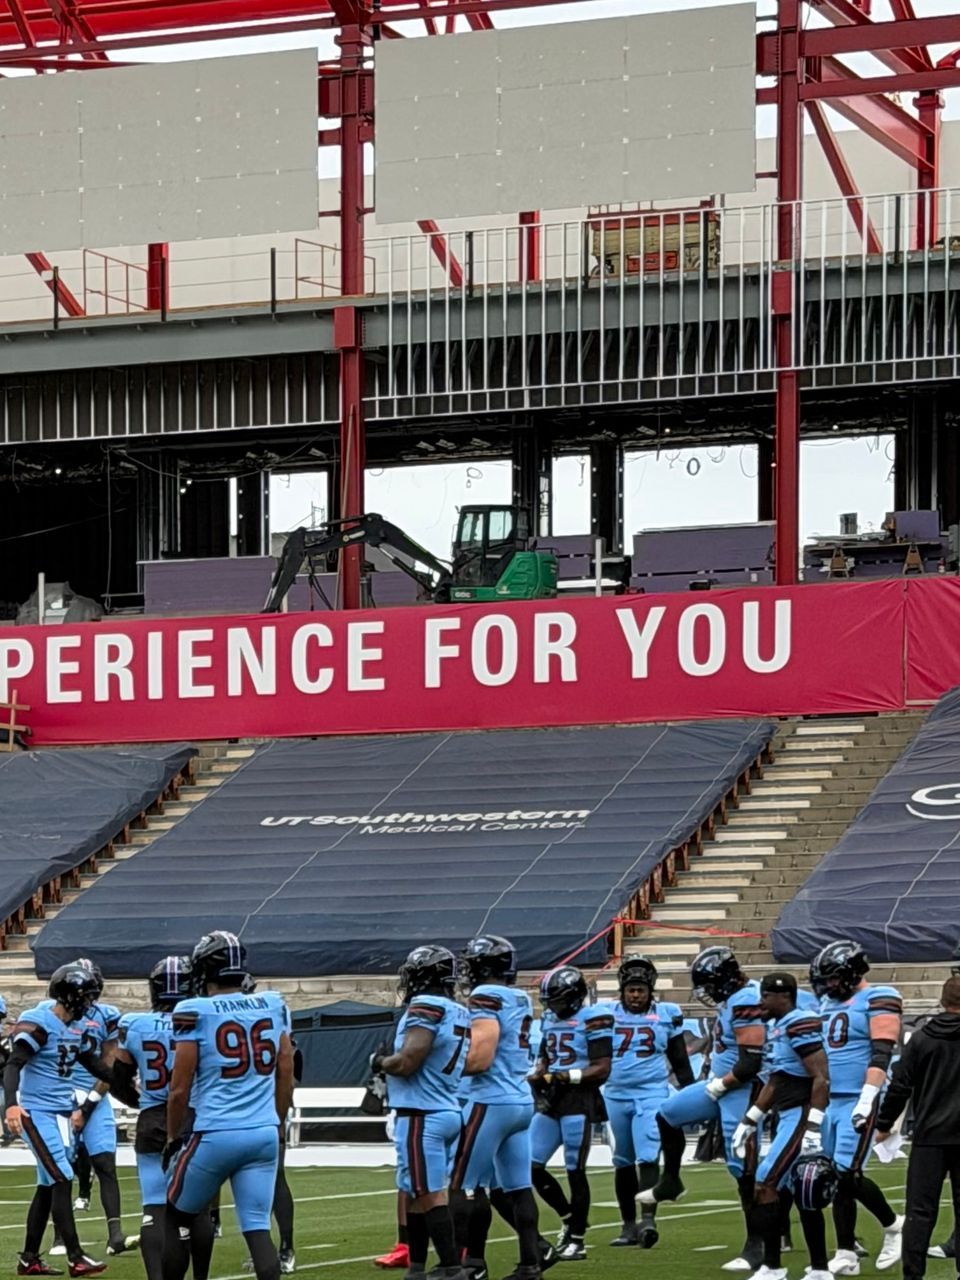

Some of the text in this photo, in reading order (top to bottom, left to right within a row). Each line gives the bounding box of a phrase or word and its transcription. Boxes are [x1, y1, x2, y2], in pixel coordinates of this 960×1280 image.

[424, 611, 578, 689] FOR
[615, 599, 793, 678] YOU
[360, 820, 585, 834] Medical Center
[213, 998, 270, 1014] FRANKLIN
[153, 1019, 173, 1032] TYL
[214, 1017, 278, 1080] 96
[614, 1026, 657, 1058] 73
[141, 1040, 177, 1090] 3
